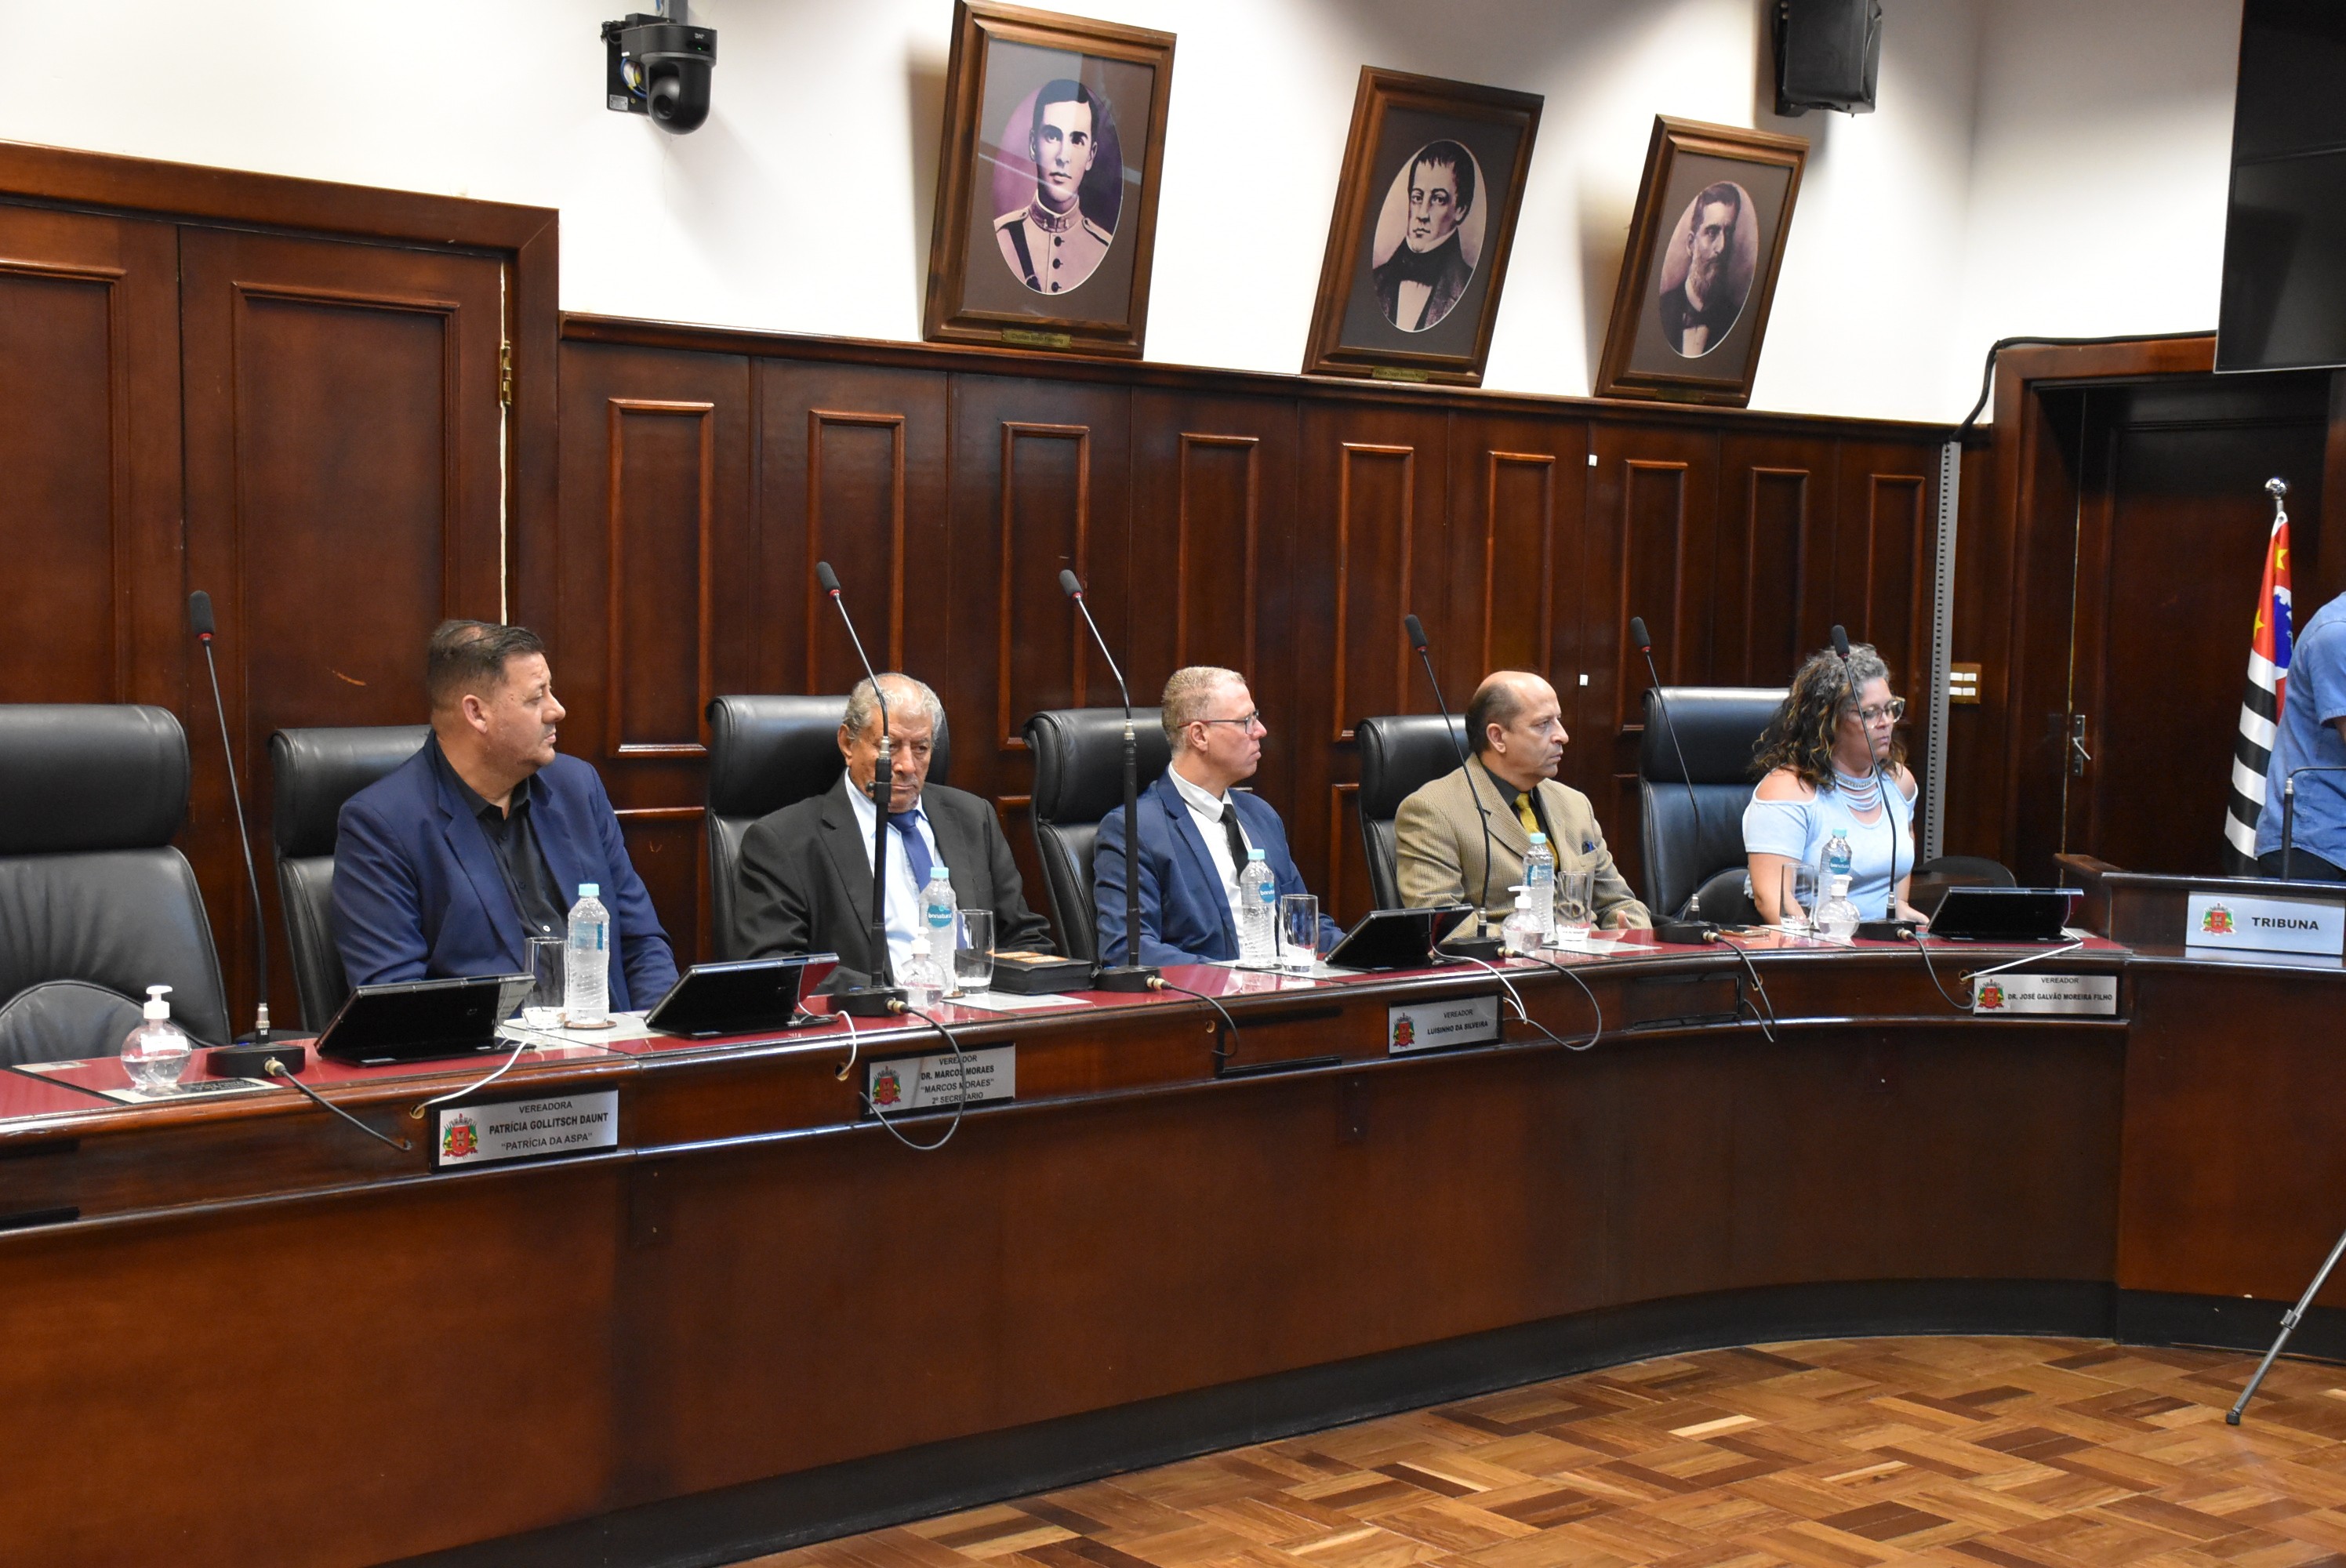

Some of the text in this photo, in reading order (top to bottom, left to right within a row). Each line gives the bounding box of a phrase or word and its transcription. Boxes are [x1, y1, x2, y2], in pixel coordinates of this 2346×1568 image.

[2251, 916, 2319, 931] TRIBUNA
[1444, 1008, 1473, 1018] VEREADOR
[1427, 1025, 1454, 1035] LUISINHO
[1464, 1020, 1488, 1031] SILVEIRA
[921, 1072, 933, 1080] DR.
[965, 1065, 994, 1076] MORAES
[939, 1091, 984, 1104] SECREARIO
[518, 1101, 573, 1114] VEREADORA
[488, 1112, 608, 1135] PATRÍCIA GOLLITSCH DAUNT
[550, 1136, 562, 1145] DA
